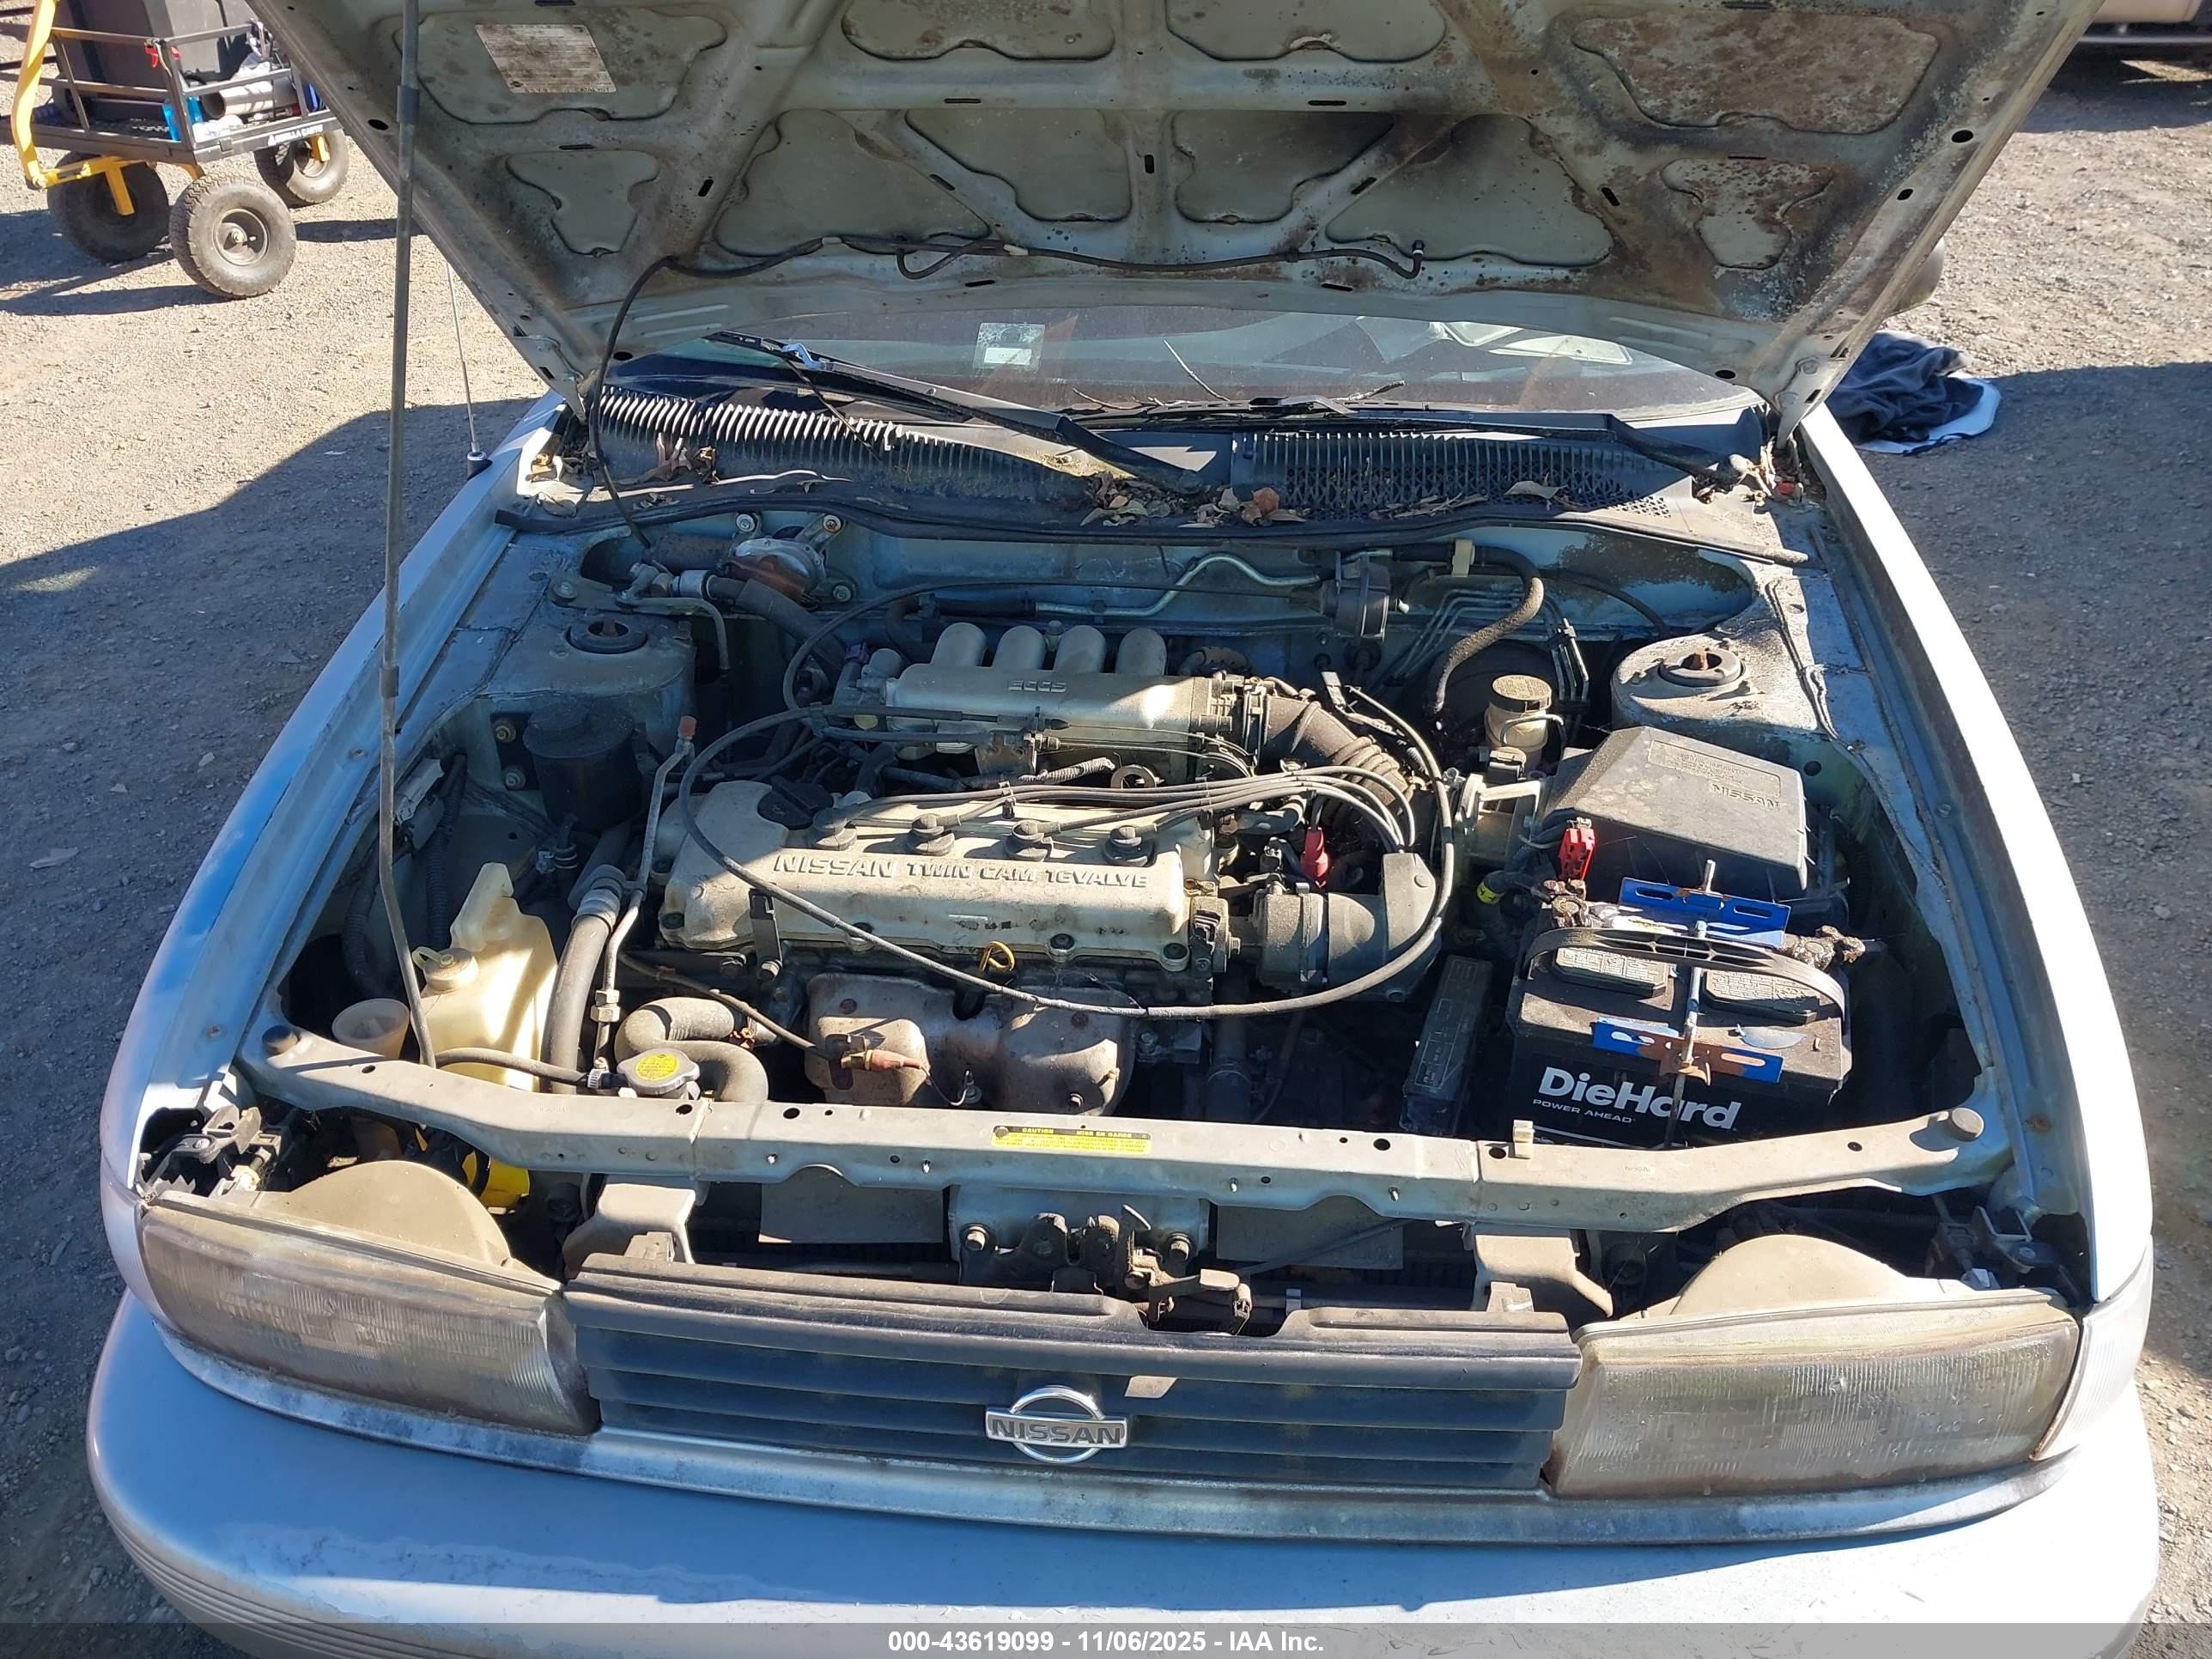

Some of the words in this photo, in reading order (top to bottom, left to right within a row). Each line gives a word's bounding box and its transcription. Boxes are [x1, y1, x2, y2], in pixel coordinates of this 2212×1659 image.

[1711, 783, 1780, 811] NISSAN
[773, 854, 895, 878] NISSAN
[907, 862, 973, 878] TWIN
[980, 866, 1035, 882] CAM
[1533, 1098, 1581, 1114] POWER
[1584, 1109, 1632, 1124] AHEAD
[1538, 1066, 1742, 1130] DieHard
[992, 1419, 1121, 1444] NISSAN
